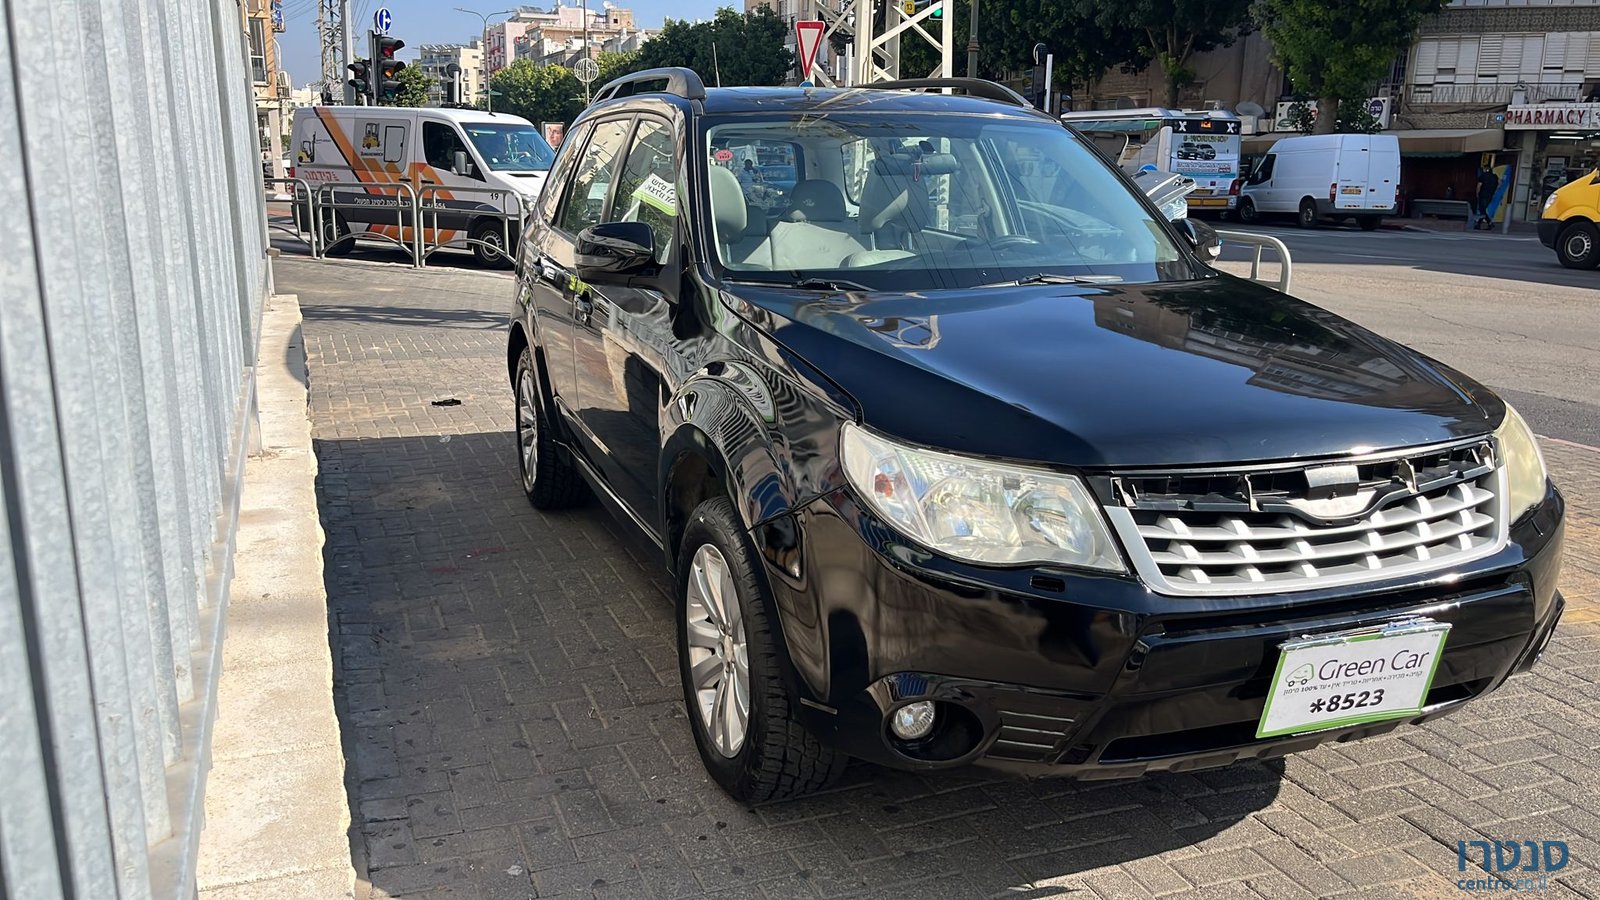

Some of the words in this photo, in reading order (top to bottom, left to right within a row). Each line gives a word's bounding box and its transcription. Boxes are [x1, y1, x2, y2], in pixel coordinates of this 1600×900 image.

[1505, 109, 1585, 125] PHARMACY
[1319, 658, 1386, 681] Green
[1391, 649, 1430, 671] Car
